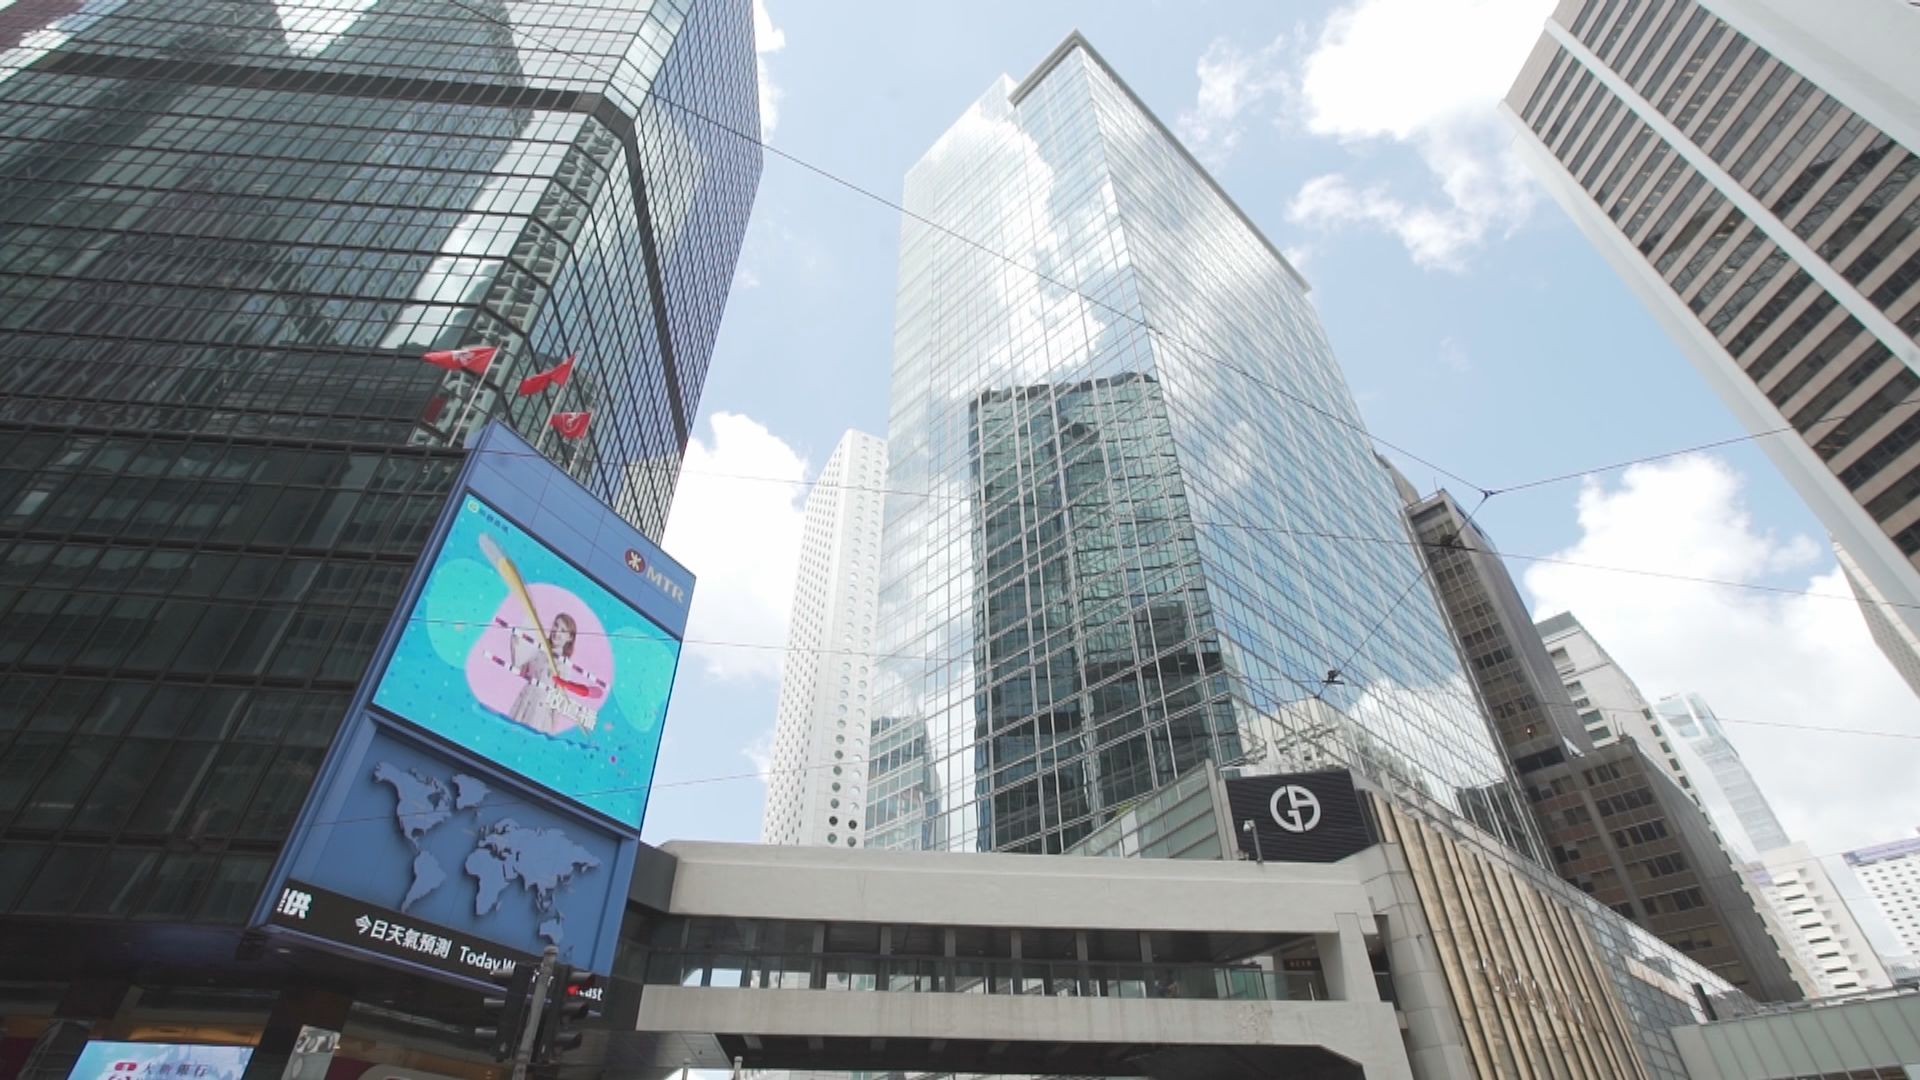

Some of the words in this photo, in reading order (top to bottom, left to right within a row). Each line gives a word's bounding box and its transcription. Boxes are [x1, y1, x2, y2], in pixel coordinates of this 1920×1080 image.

[647, 566, 684, 604] MTR
[354, 913, 453, 959] 今日天氣預測
[459, 946, 502, 975] Today
